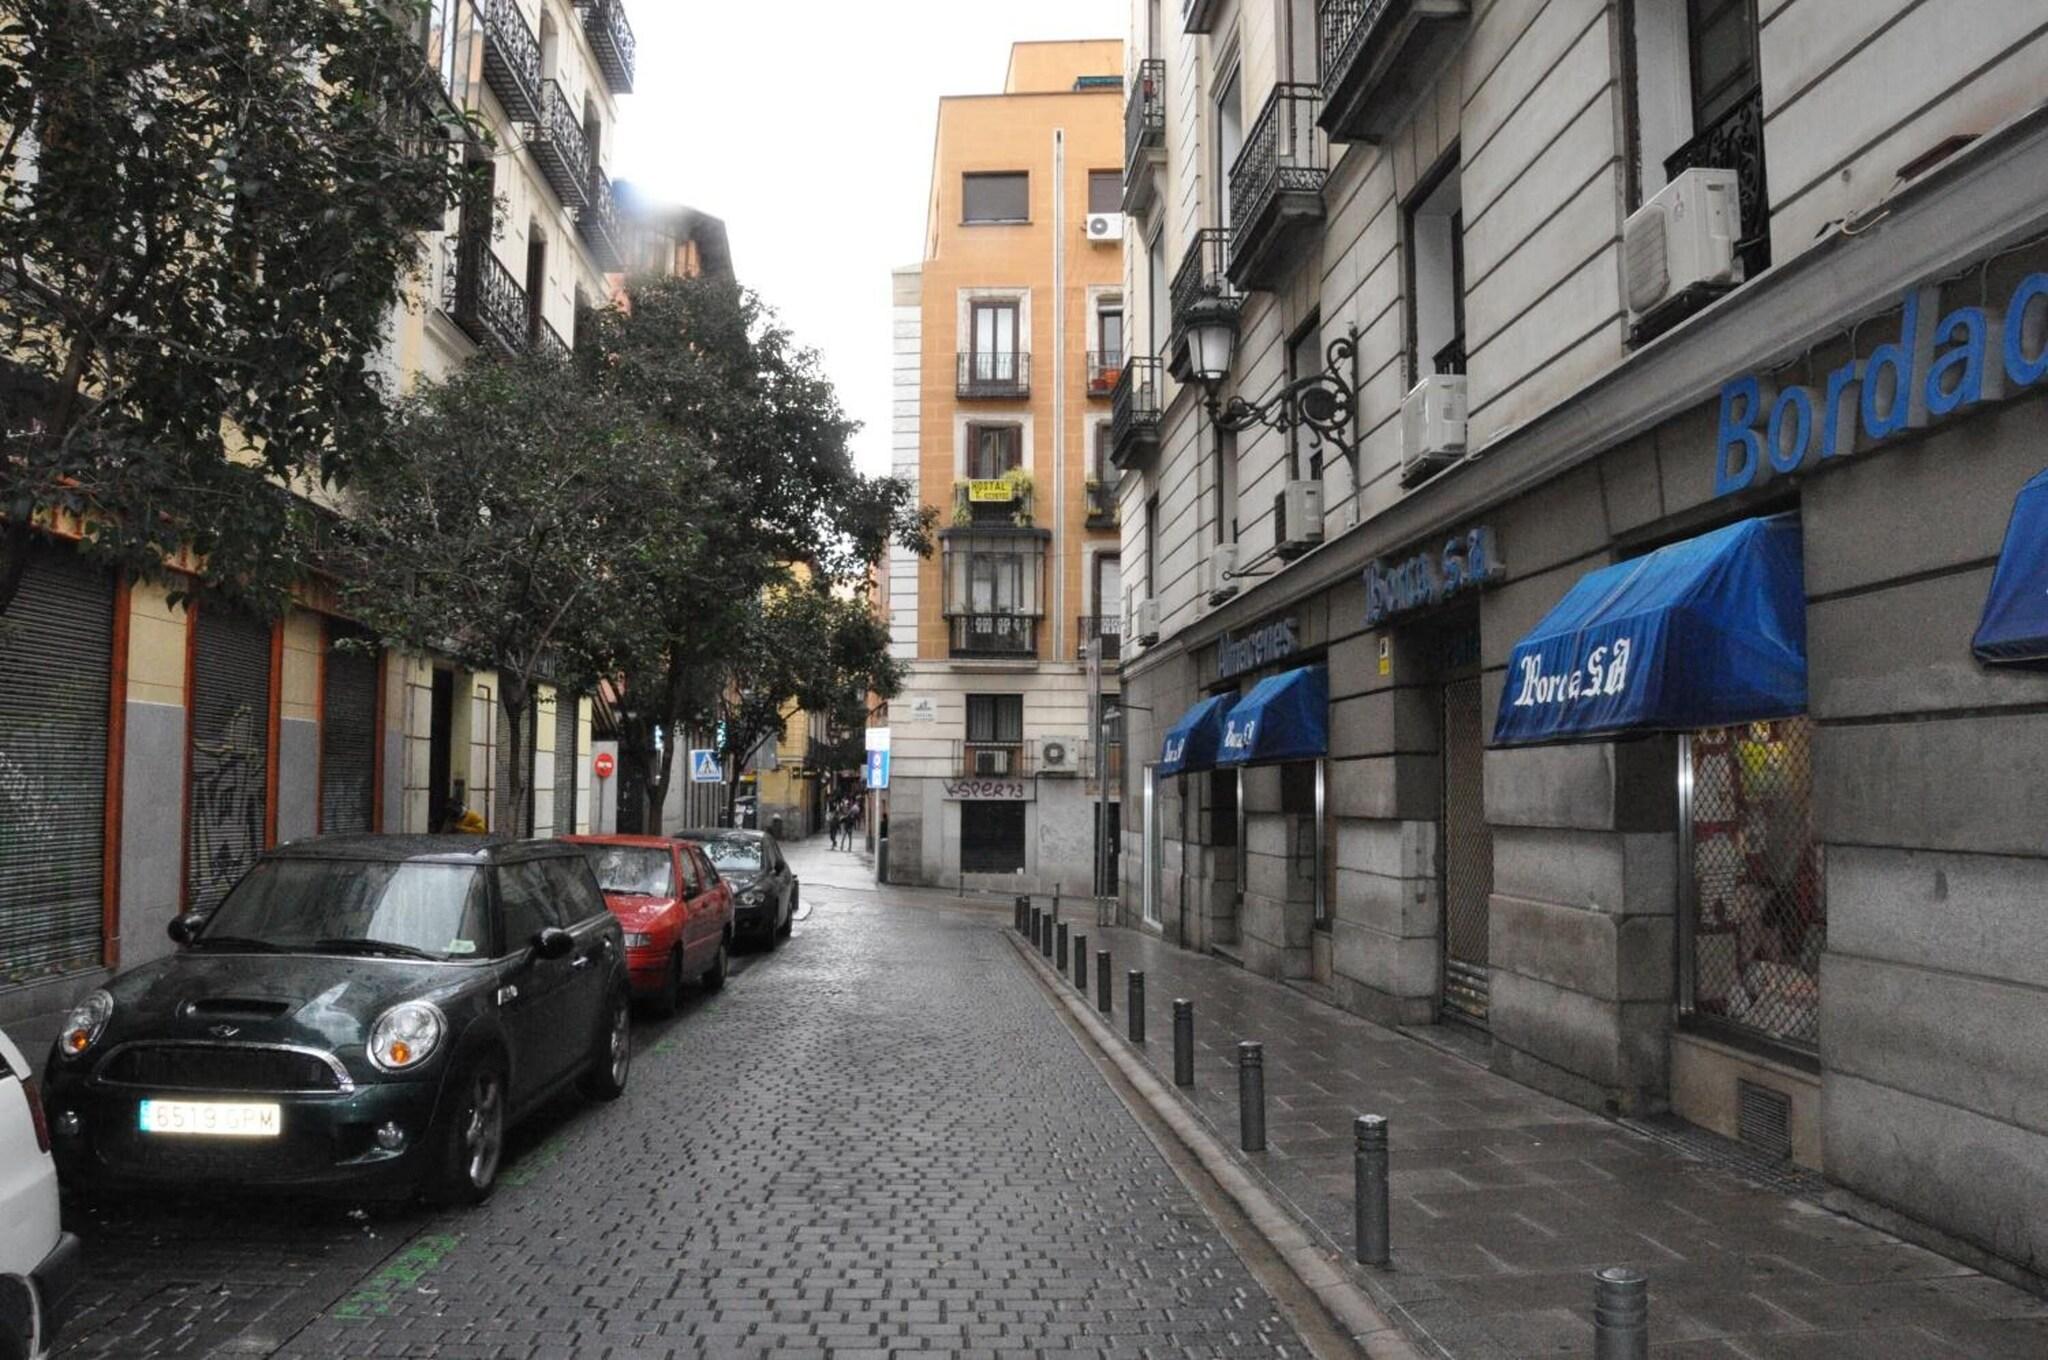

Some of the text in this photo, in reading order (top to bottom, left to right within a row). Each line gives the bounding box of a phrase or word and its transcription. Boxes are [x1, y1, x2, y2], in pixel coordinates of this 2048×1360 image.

[972, 480, 1006, 491] HOSTAL
[156, 1105, 273, 1131] 6519 GPM
